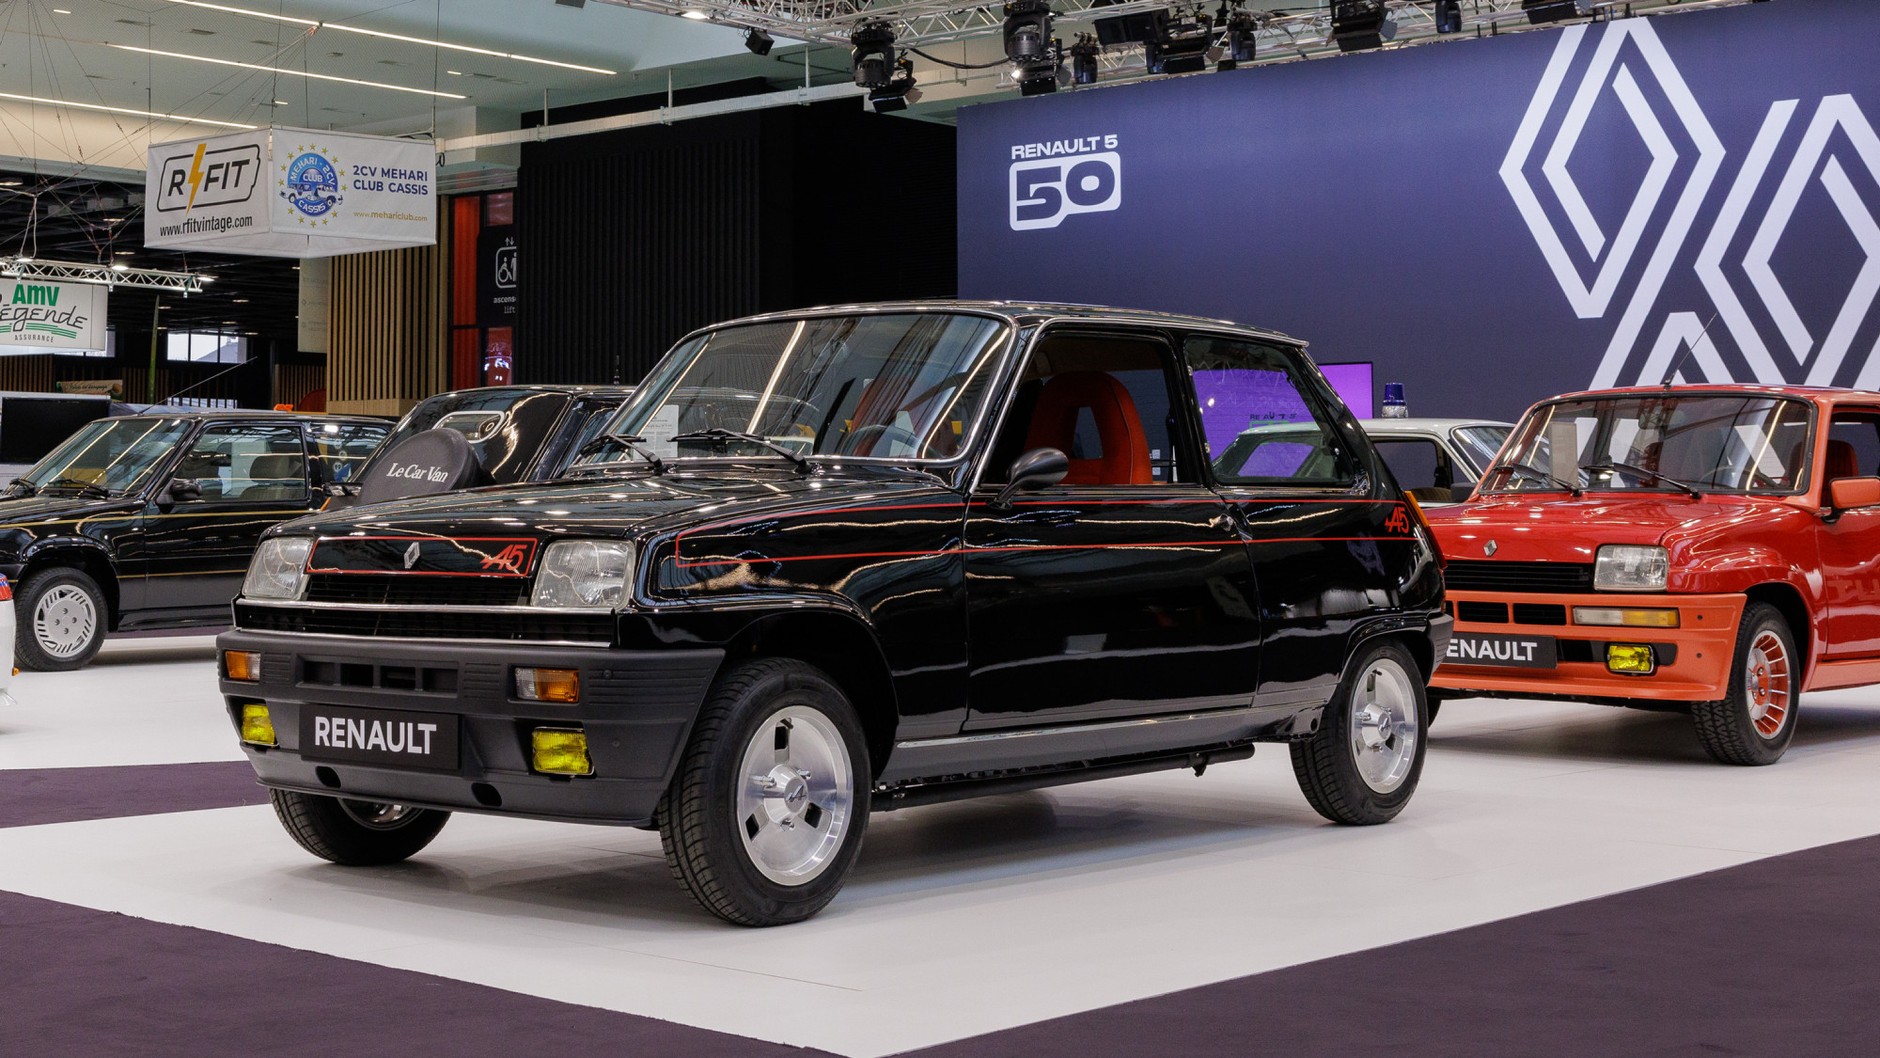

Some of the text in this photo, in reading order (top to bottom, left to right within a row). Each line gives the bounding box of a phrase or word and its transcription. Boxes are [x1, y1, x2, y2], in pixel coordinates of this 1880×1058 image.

[1011, 134, 1118, 160] RENAULT 5
[291, 157, 318, 181] MEHARI
[303, 173, 323, 183] CLUB
[353, 165, 428, 181] 2CV MEHARI
[353, 179, 428, 196] CLUB CASSIS
[1016, 160, 1116, 222] 50
[298, 199, 326, 214] CASSIS
[353, 210, 428, 222] www.mehariclub.com
[160, 215, 253, 237] www.rfitvintage.com
[493, 296, 517, 304] ascens
[0, 302, 88, 332] égende
[14, 334, 54, 343] ASSURANCE
[386, 462, 449, 483] Le Car Van
[1446, 638, 1538, 661] ENAULT
[315, 716, 437, 754] RENAULT
